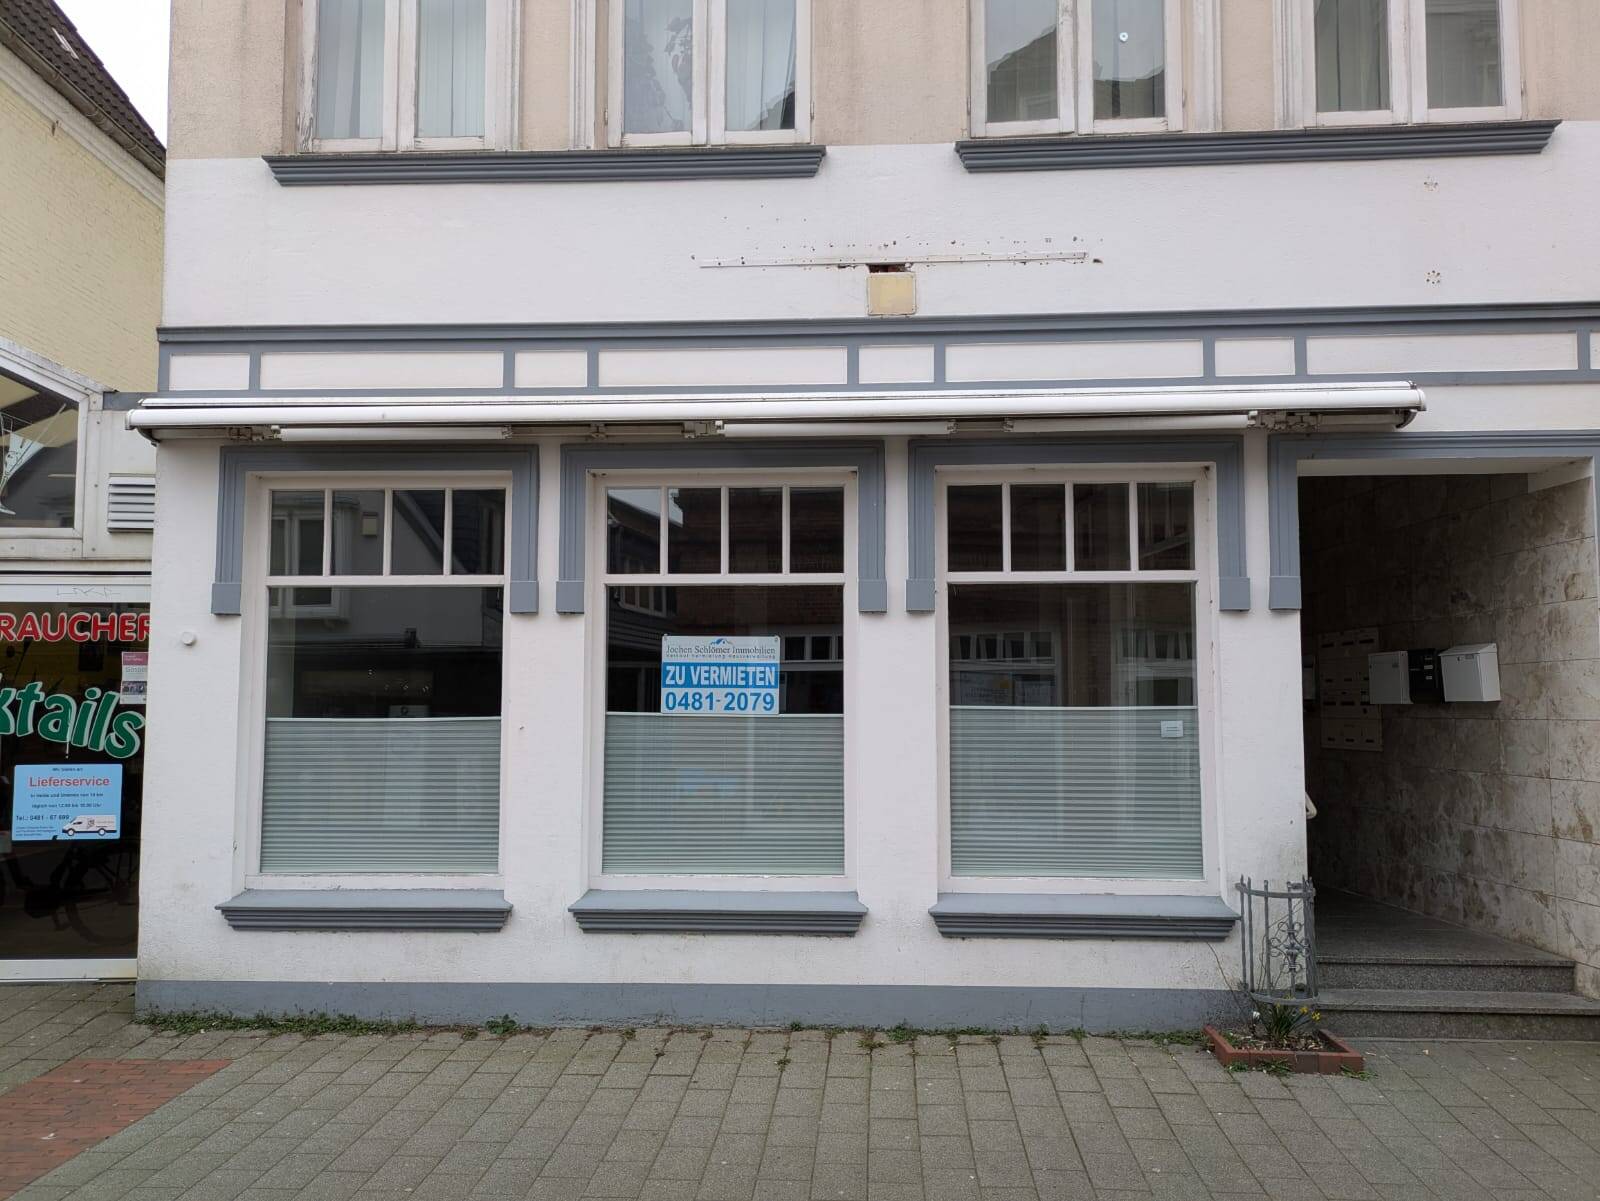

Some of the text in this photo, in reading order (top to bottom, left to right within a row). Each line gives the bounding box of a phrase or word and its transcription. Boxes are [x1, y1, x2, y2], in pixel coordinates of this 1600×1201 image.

[666, 645, 776, 654] Jochen Schlömer Immobilien
[665, 665, 775, 686] ZU VERMIETEN
[29, 776, 110, 787] Lieferservice
